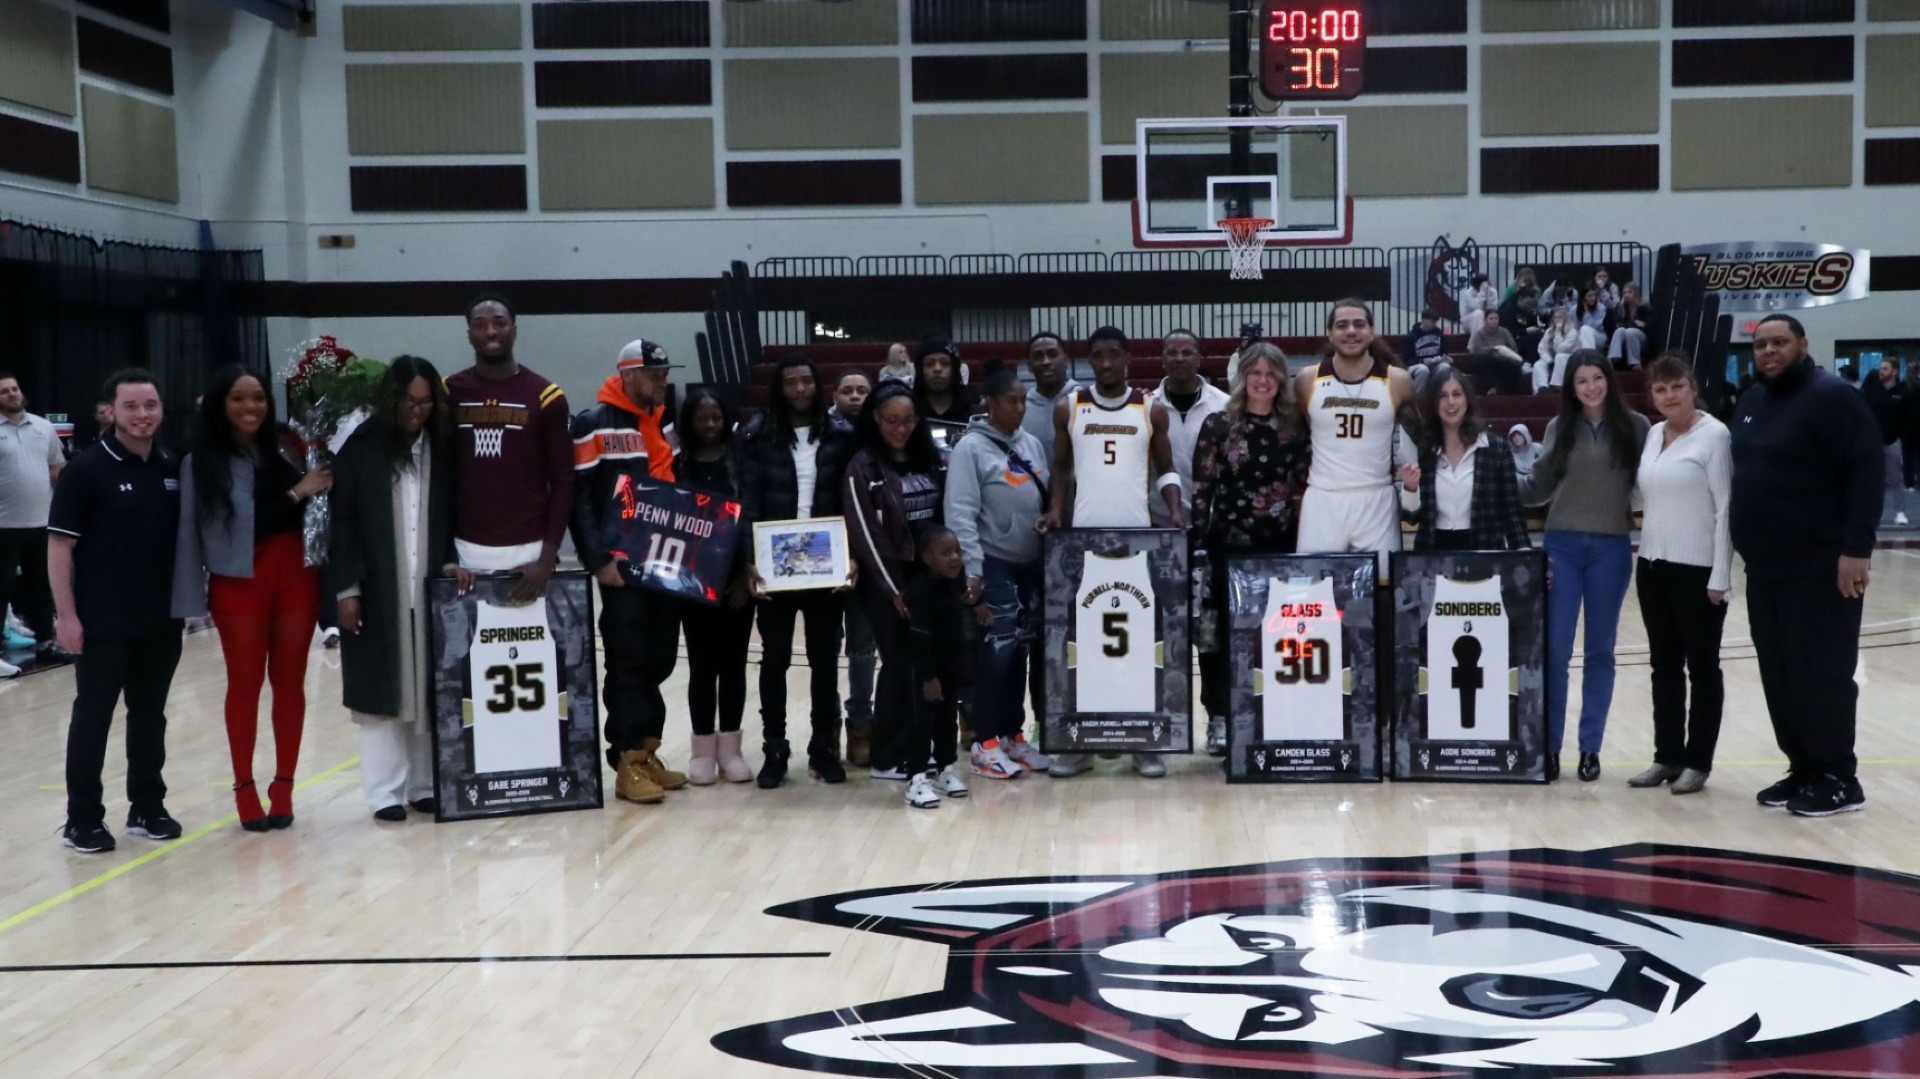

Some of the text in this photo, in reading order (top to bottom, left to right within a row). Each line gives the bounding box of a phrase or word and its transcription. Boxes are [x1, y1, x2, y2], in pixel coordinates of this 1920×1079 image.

[1269, 10, 1360, 41] 20:00
[1291, 48, 1339, 89] 30
[1716, 250, 1815, 260] BLOOMSBURG
[1335, 413, 1364, 438] 30
[1104, 441, 1116, 465] 5
[634, 502, 713, 538] PENN WOOD
[643, 533, 686, 579] 10
[1082, 582, 1151, 609] PURNELL-NORTHERN
[1281, 604, 1322, 617] GLASS
[1435, 602, 1501, 617] SONDBERG
[480, 626, 545, 644] SPRINGER
[1103, 612, 1129, 658] 5
[1275, 638, 1330, 684] 30
[484, 662, 546, 714] 35
[1275, 748, 1331, 757] CAMDEN GLASS
[1440, 748, 1496, 757] ADDIE SONDBERG
[488, 777, 548, 791] GABE SPRINGER
